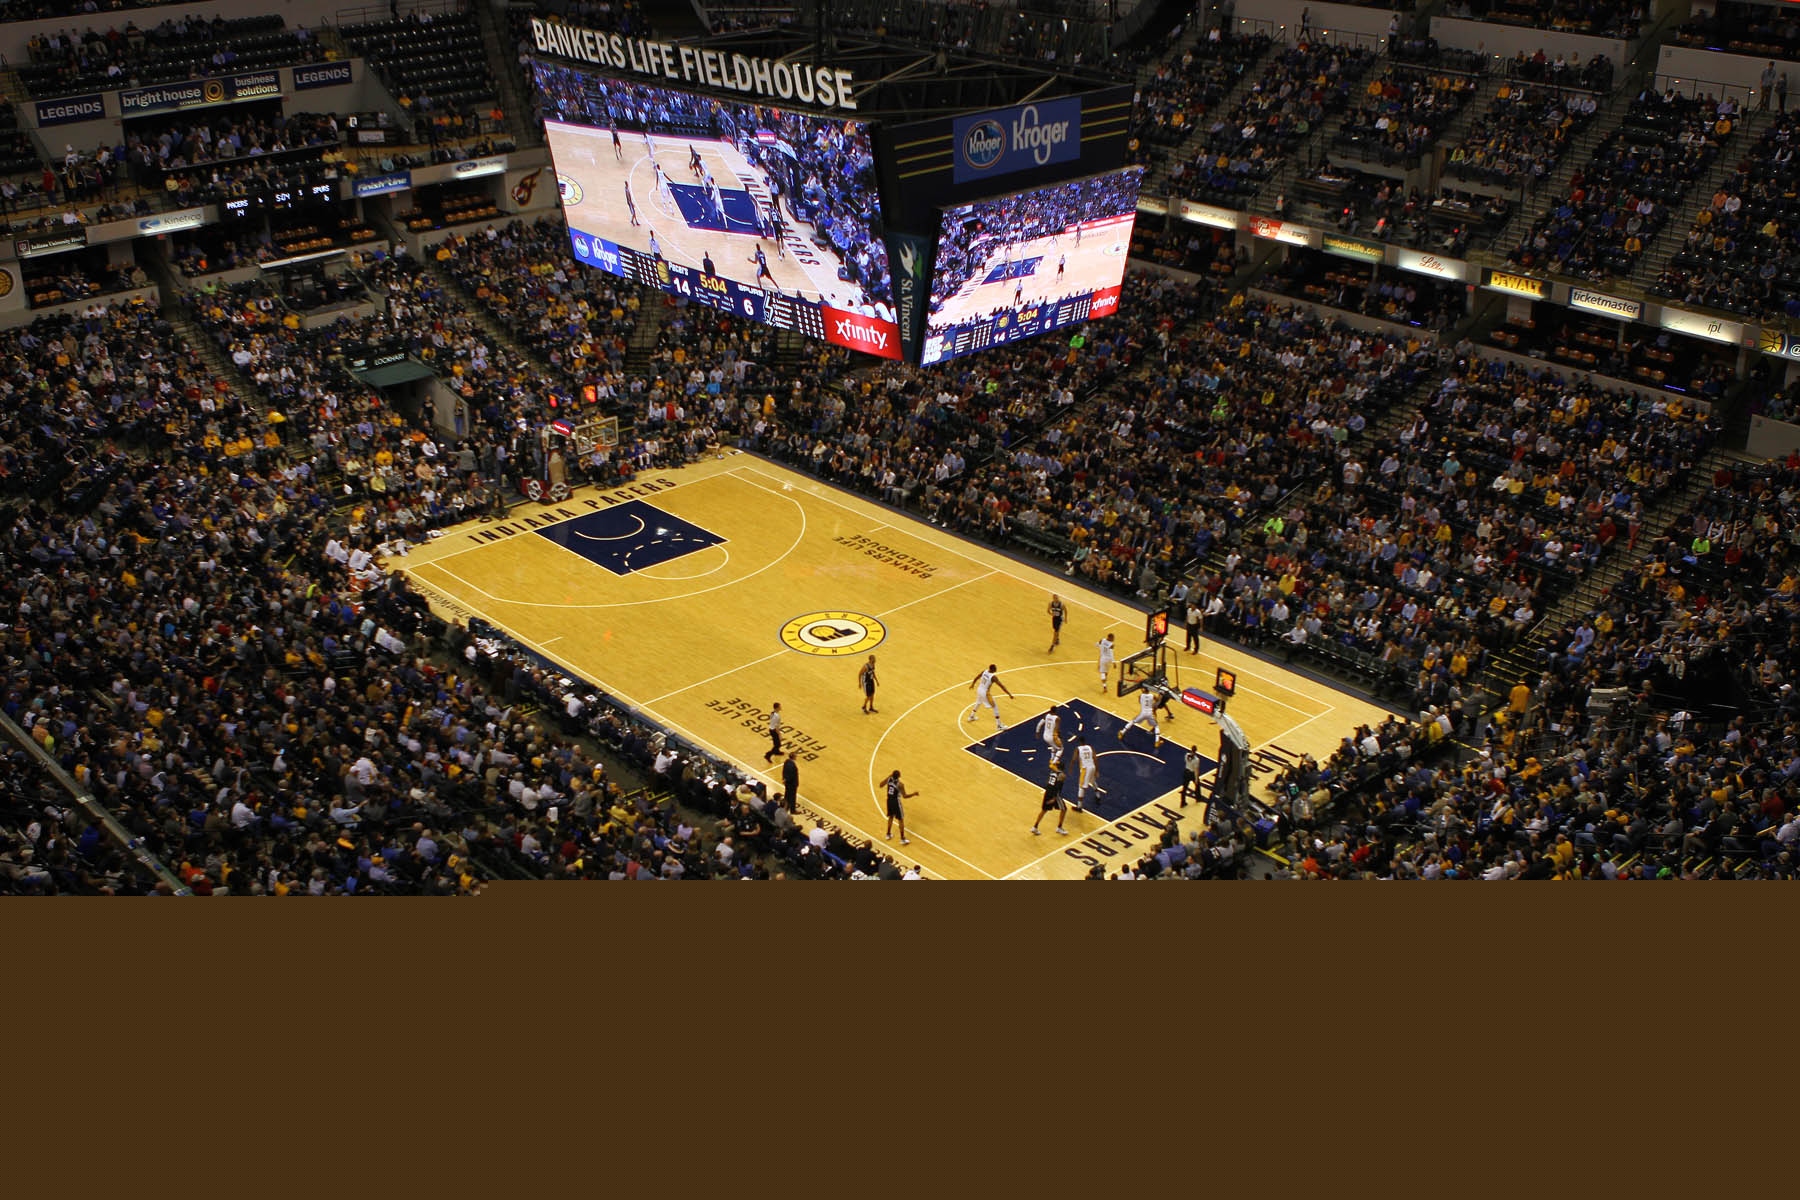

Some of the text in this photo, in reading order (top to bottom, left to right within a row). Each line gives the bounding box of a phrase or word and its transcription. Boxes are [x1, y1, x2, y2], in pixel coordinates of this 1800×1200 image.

[532, 18, 857, 109] BANKERS LIFE FIELDHOUSE
[235, 75, 275, 87] business
[295, 68, 350, 84] LEGENDS
[122, 88, 201, 107] bright house
[236, 84, 279, 97] solutions
[39, 102, 102, 120] LEGENDS
[969, 128, 1001, 161] Kroger
[1012, 105, 1069, 165] Kroger
[226, 200, 248, 209] PACERS
[164, 213, 202, 226] Kinetico
[591, 238, 619, 272] Kroger
[1324, 236, 1384, 257] bankerslife.com
[668, 262, 689, 276] Pacers
[1419, 255, 1445, 272] Lilly
[673, 277, 691, 296] 14
[700, 273, 727, 294] 5:04
[743, 299, 754, 316] 6
[1091, 295, 1118, 311] xfinity
[1573, 290, 1639, 314] ticketmaster
[901, 297, 914, 342] Vincent
[1017, 308, 1038, 323] 5:04
[1044, 319, 1051, 330] 6
[835, 318, 888, 350] xfinity
[1707, 321, 1722, 335] ipl
[993, 333, 1006, 344] 14
[374, 353, 405, 366] LOCKHART
[467, 478, 677, 544] INDIANA PACERS
[832, 536, 933, 579] BANKERS LIFE
[850, 534, 938, 572] FIELDHOUSE
[705, 699, 819, 762] BANERS LIFE
[727, 697, 828, 752] FIELDOUSE
[1065, 803, 1185, 866] PACERS
